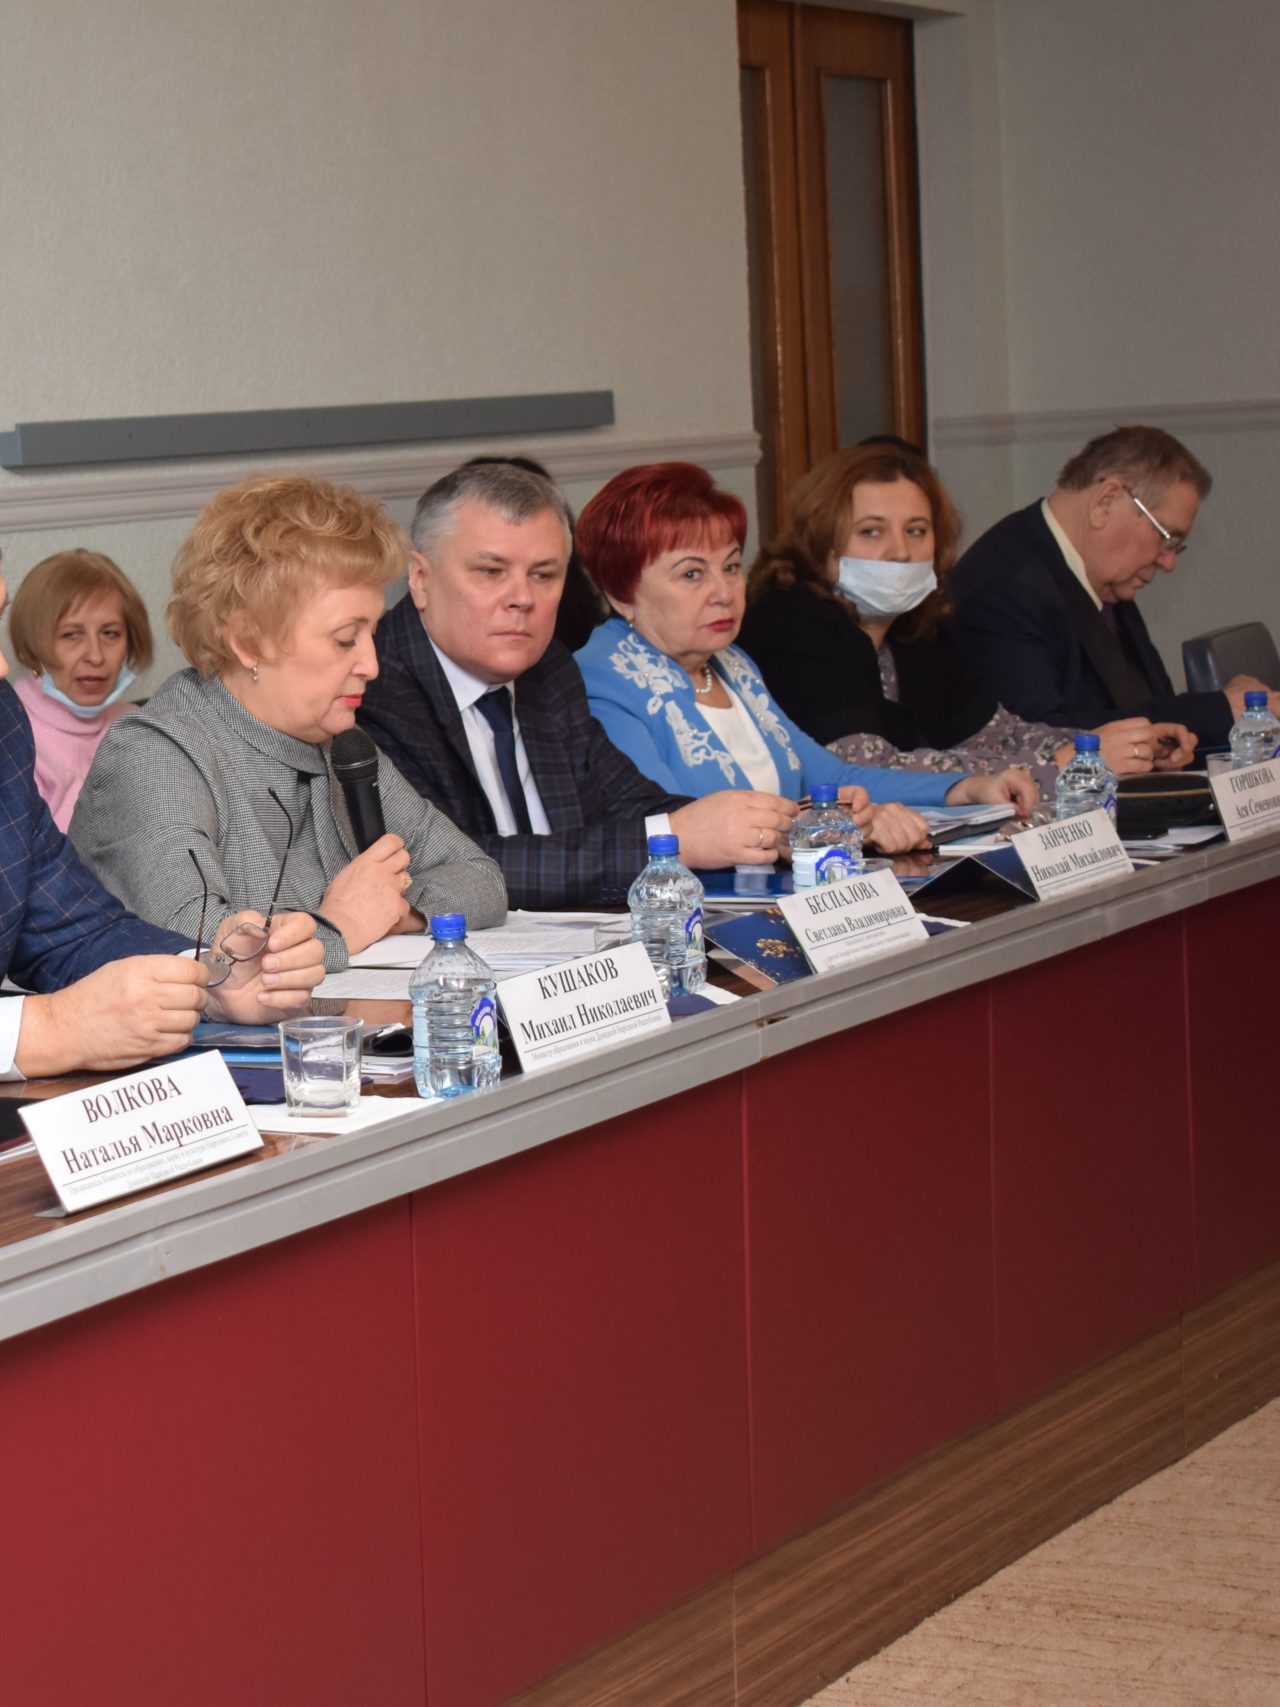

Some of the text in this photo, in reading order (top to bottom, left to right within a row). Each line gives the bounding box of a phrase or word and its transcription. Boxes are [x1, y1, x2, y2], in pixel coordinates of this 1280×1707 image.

[1038, 820, 1093, 850] ЗАЙЧЕНКО
[1031, 857, 1072, 882] Николай
[1069, 844, 1123, 872] Михайлович
[805, 881, 880, 915] БЕСПАЛОВА
[805, 921, 848, 944] Светлана
[844, 903, 908, 932] Владимировна
[537, 957, 619, 1000] КУШАКОВ
[520, 989, 658, 1045] Михаил Николаевич
[82, 1074, 183, 1124] ВОЛКОВА
[61, 1105, 234, 1174] Наталья Марковна
